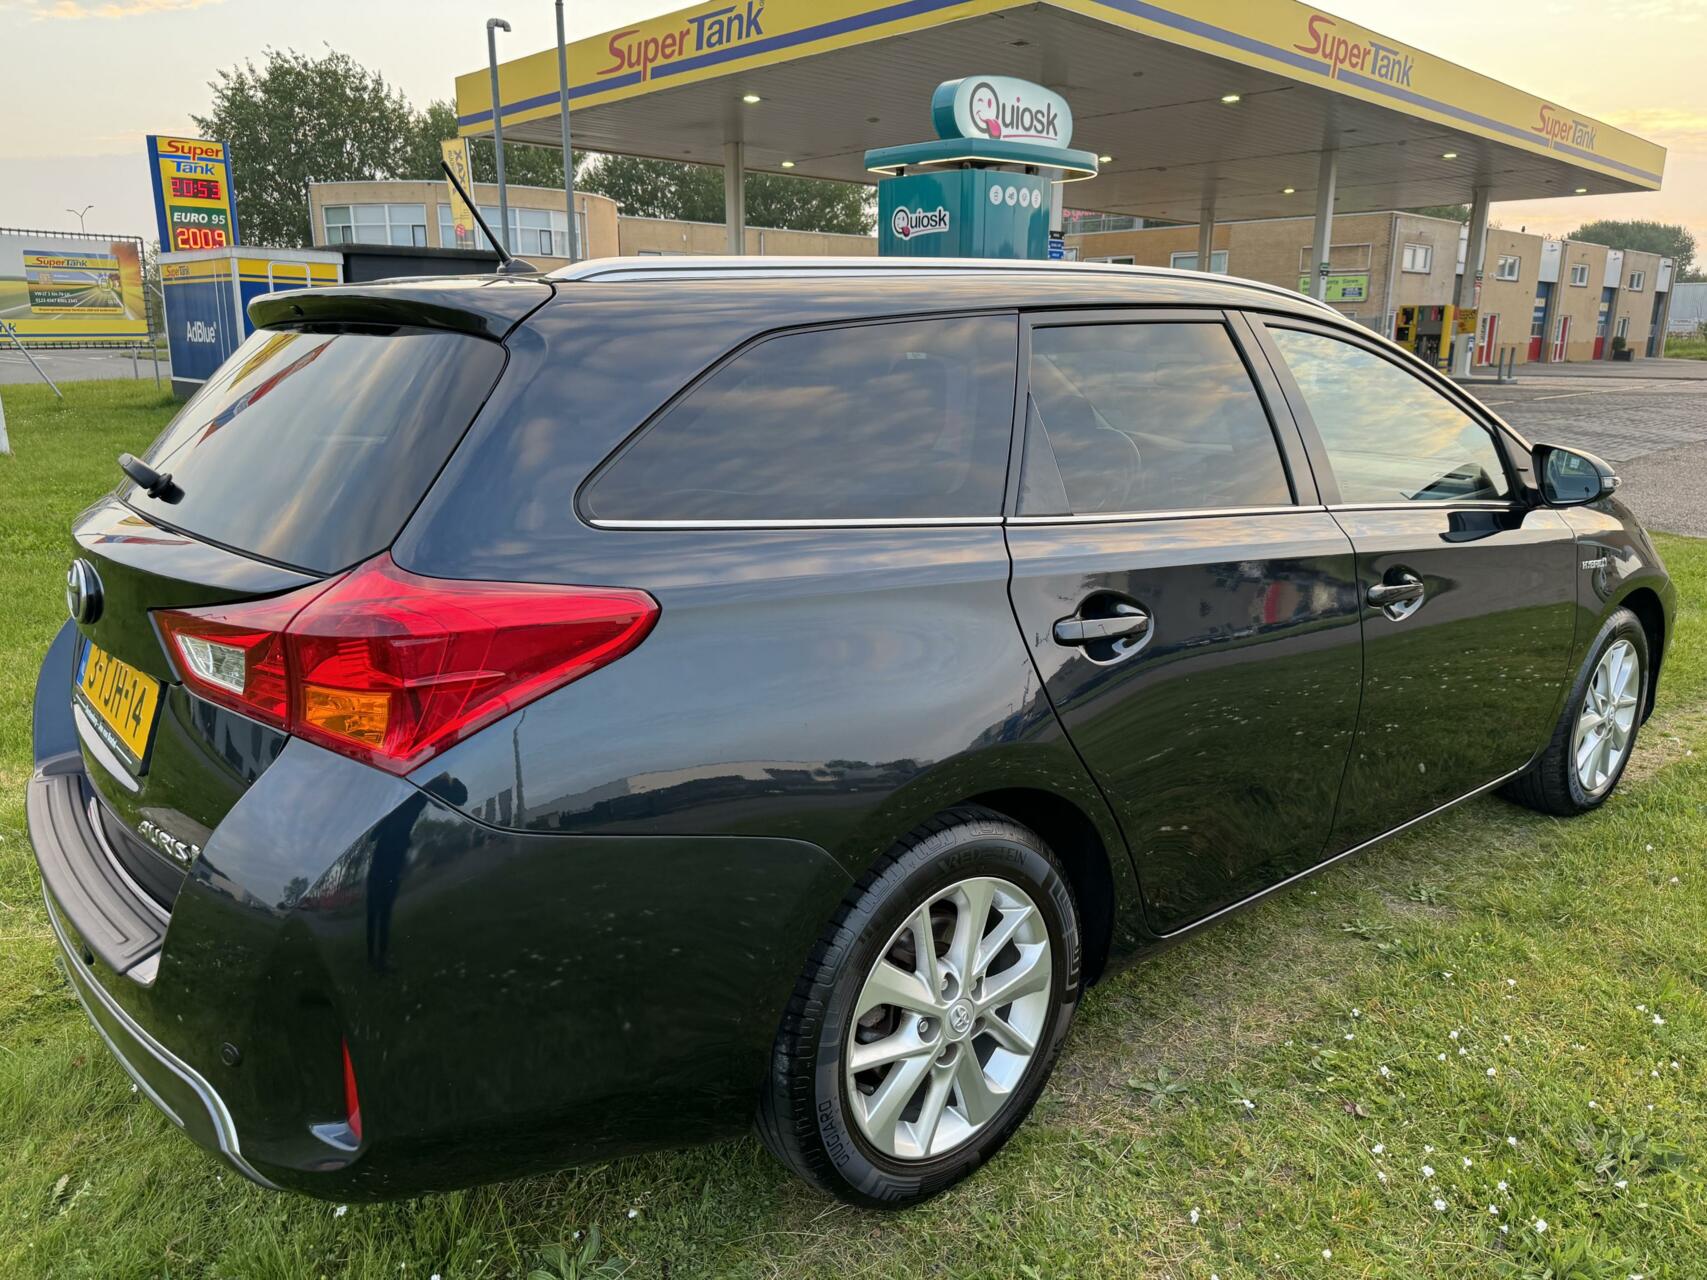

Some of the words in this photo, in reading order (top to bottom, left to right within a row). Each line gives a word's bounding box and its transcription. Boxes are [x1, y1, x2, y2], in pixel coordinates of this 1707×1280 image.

[597, 1, 764, 81] SuperTank
[1293, 15, 1413, 87] SuperTank
[969, 82, 1058, 138] Quiosk
[1531, 104, 1596, 150] SuperTank
[159, 140, 222, 161] Super
[170, 160, 215, 175] Tank
[173, 212, 208, 223] EURO
[211, 215, 226, 224] 95
[893, 207, 947, 237] Quiosk
[33, 256, 87, 268] SuperTank
